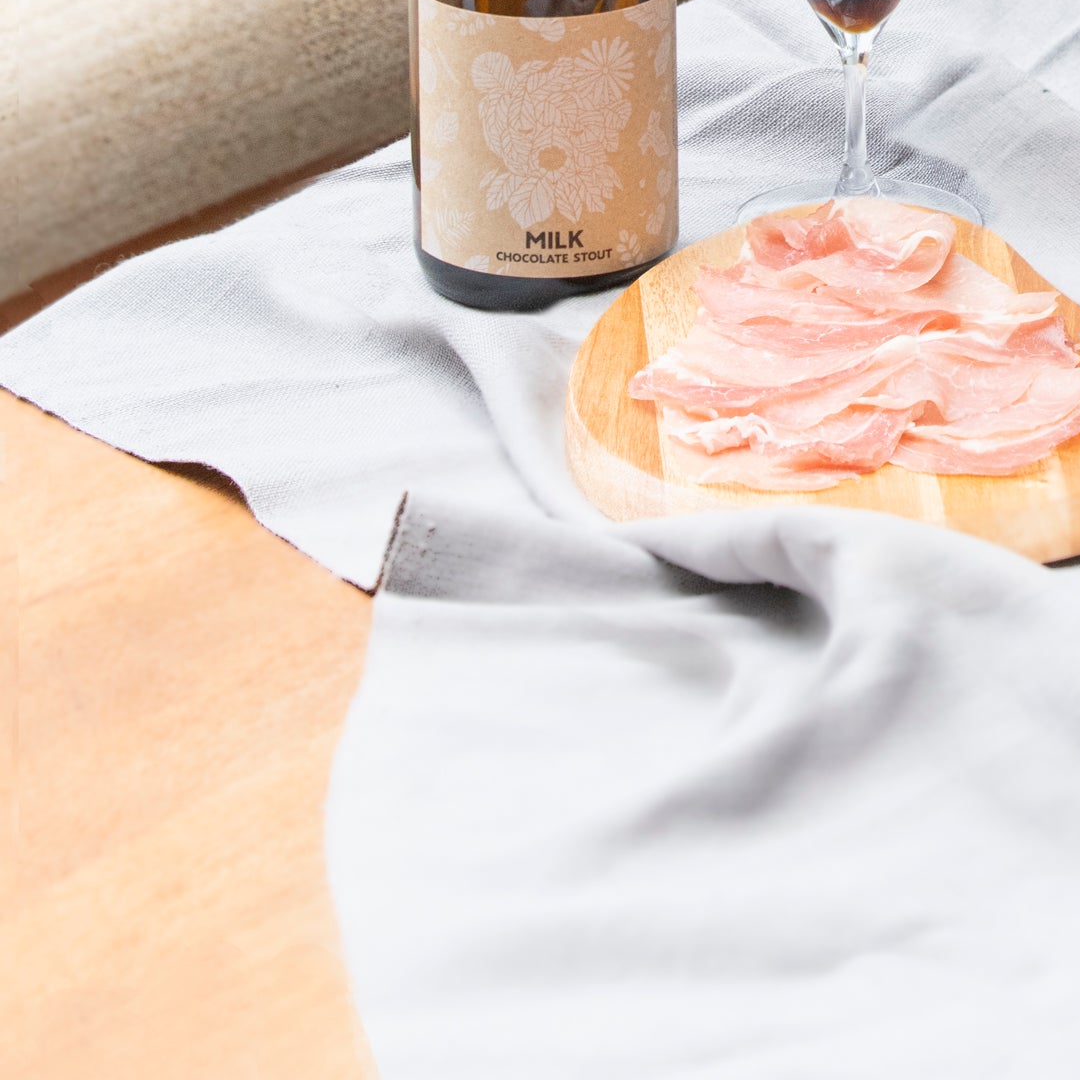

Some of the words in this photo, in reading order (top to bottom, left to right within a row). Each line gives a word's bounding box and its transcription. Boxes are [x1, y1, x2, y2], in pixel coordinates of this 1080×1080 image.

[525, 230, 584, 249] MILK
[496, 251, 569, 263] CHOCOLATE
[573, 248, 613, 263] STOUT
